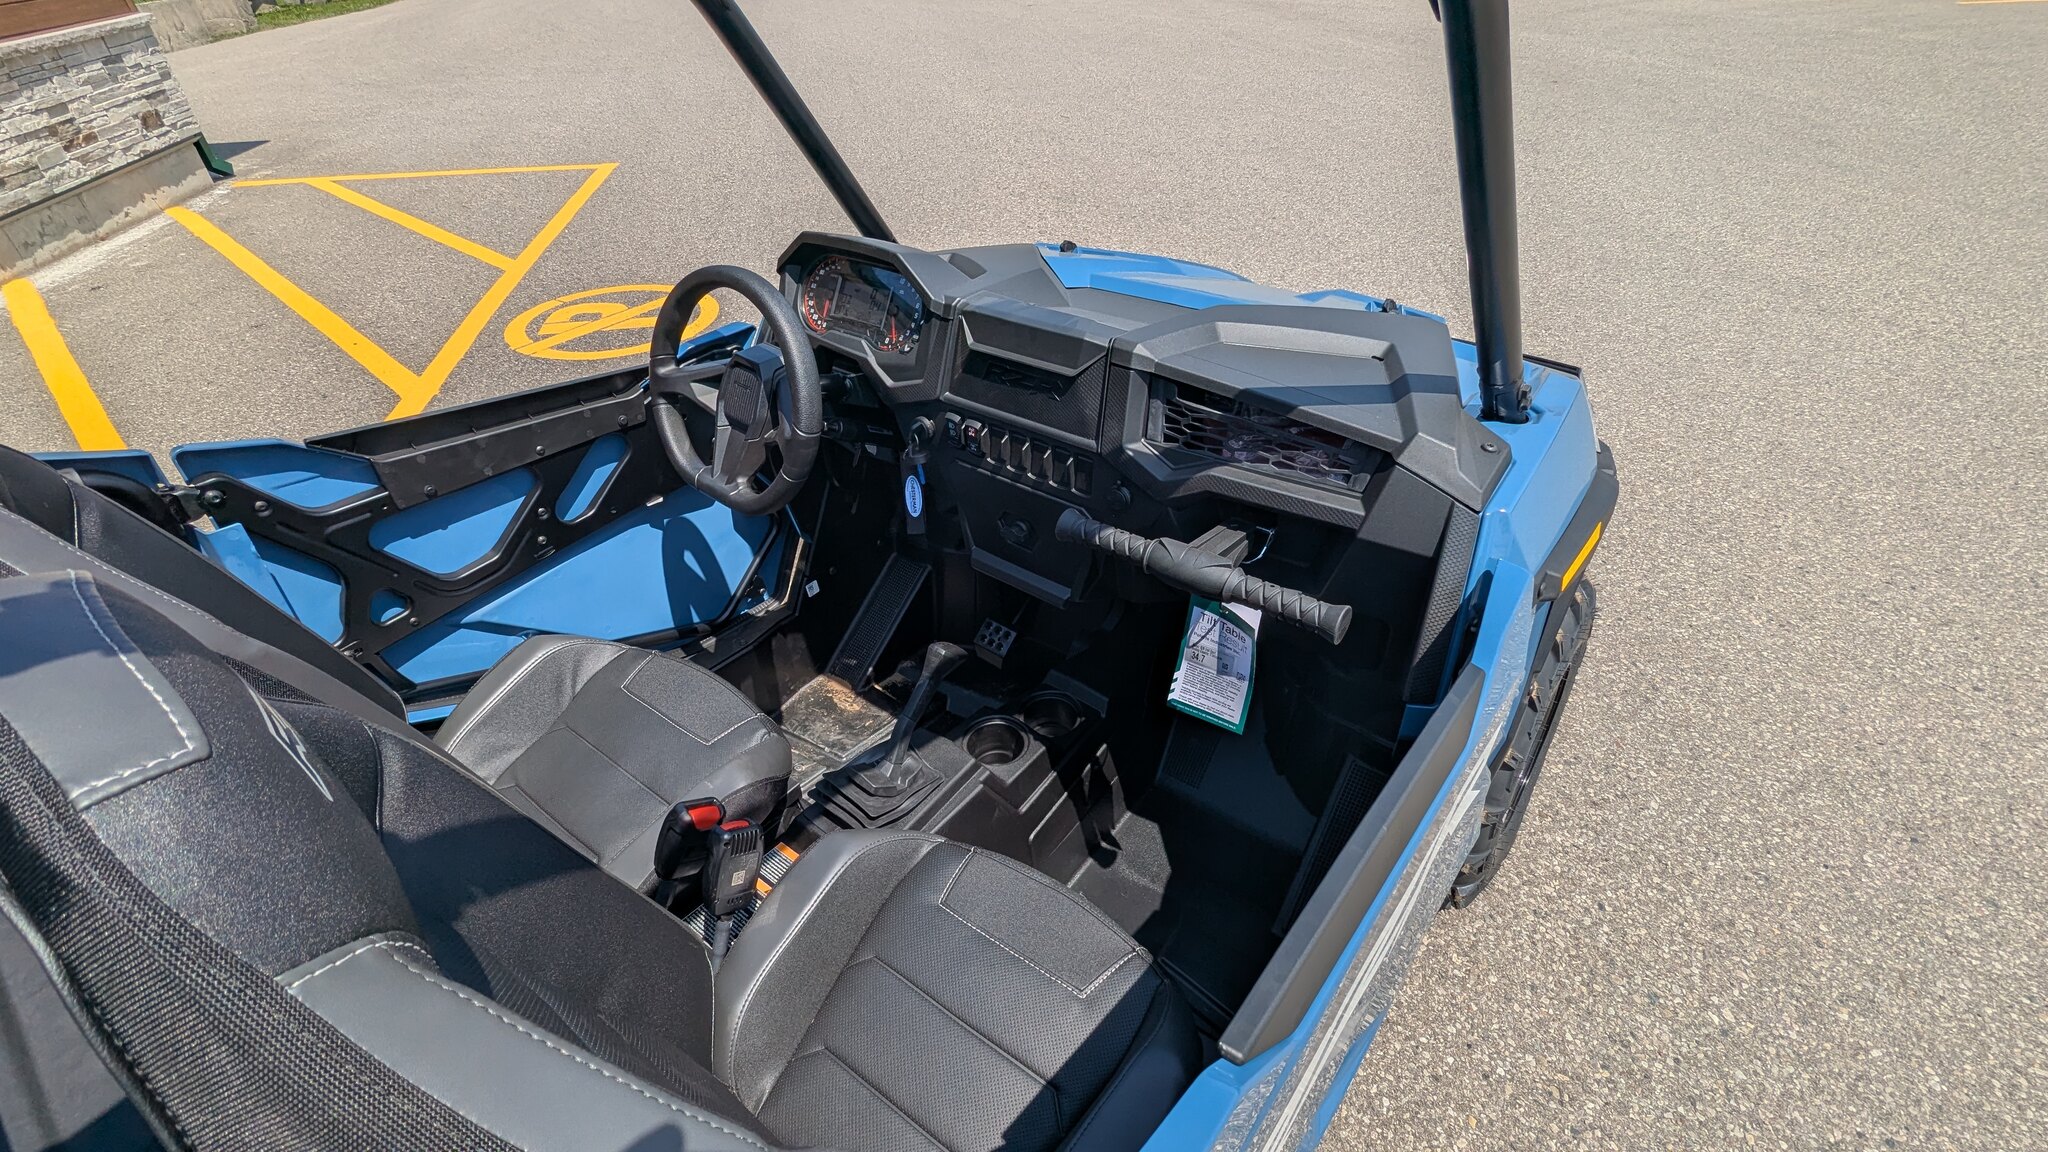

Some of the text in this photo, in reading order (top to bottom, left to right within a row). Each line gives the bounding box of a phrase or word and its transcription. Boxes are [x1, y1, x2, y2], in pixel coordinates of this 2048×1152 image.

[1200, 611, 1247, 644] Tilt Table
[1220, 631, 1248, 654] Result
[1191, 651, 1206, 663] 34.7
